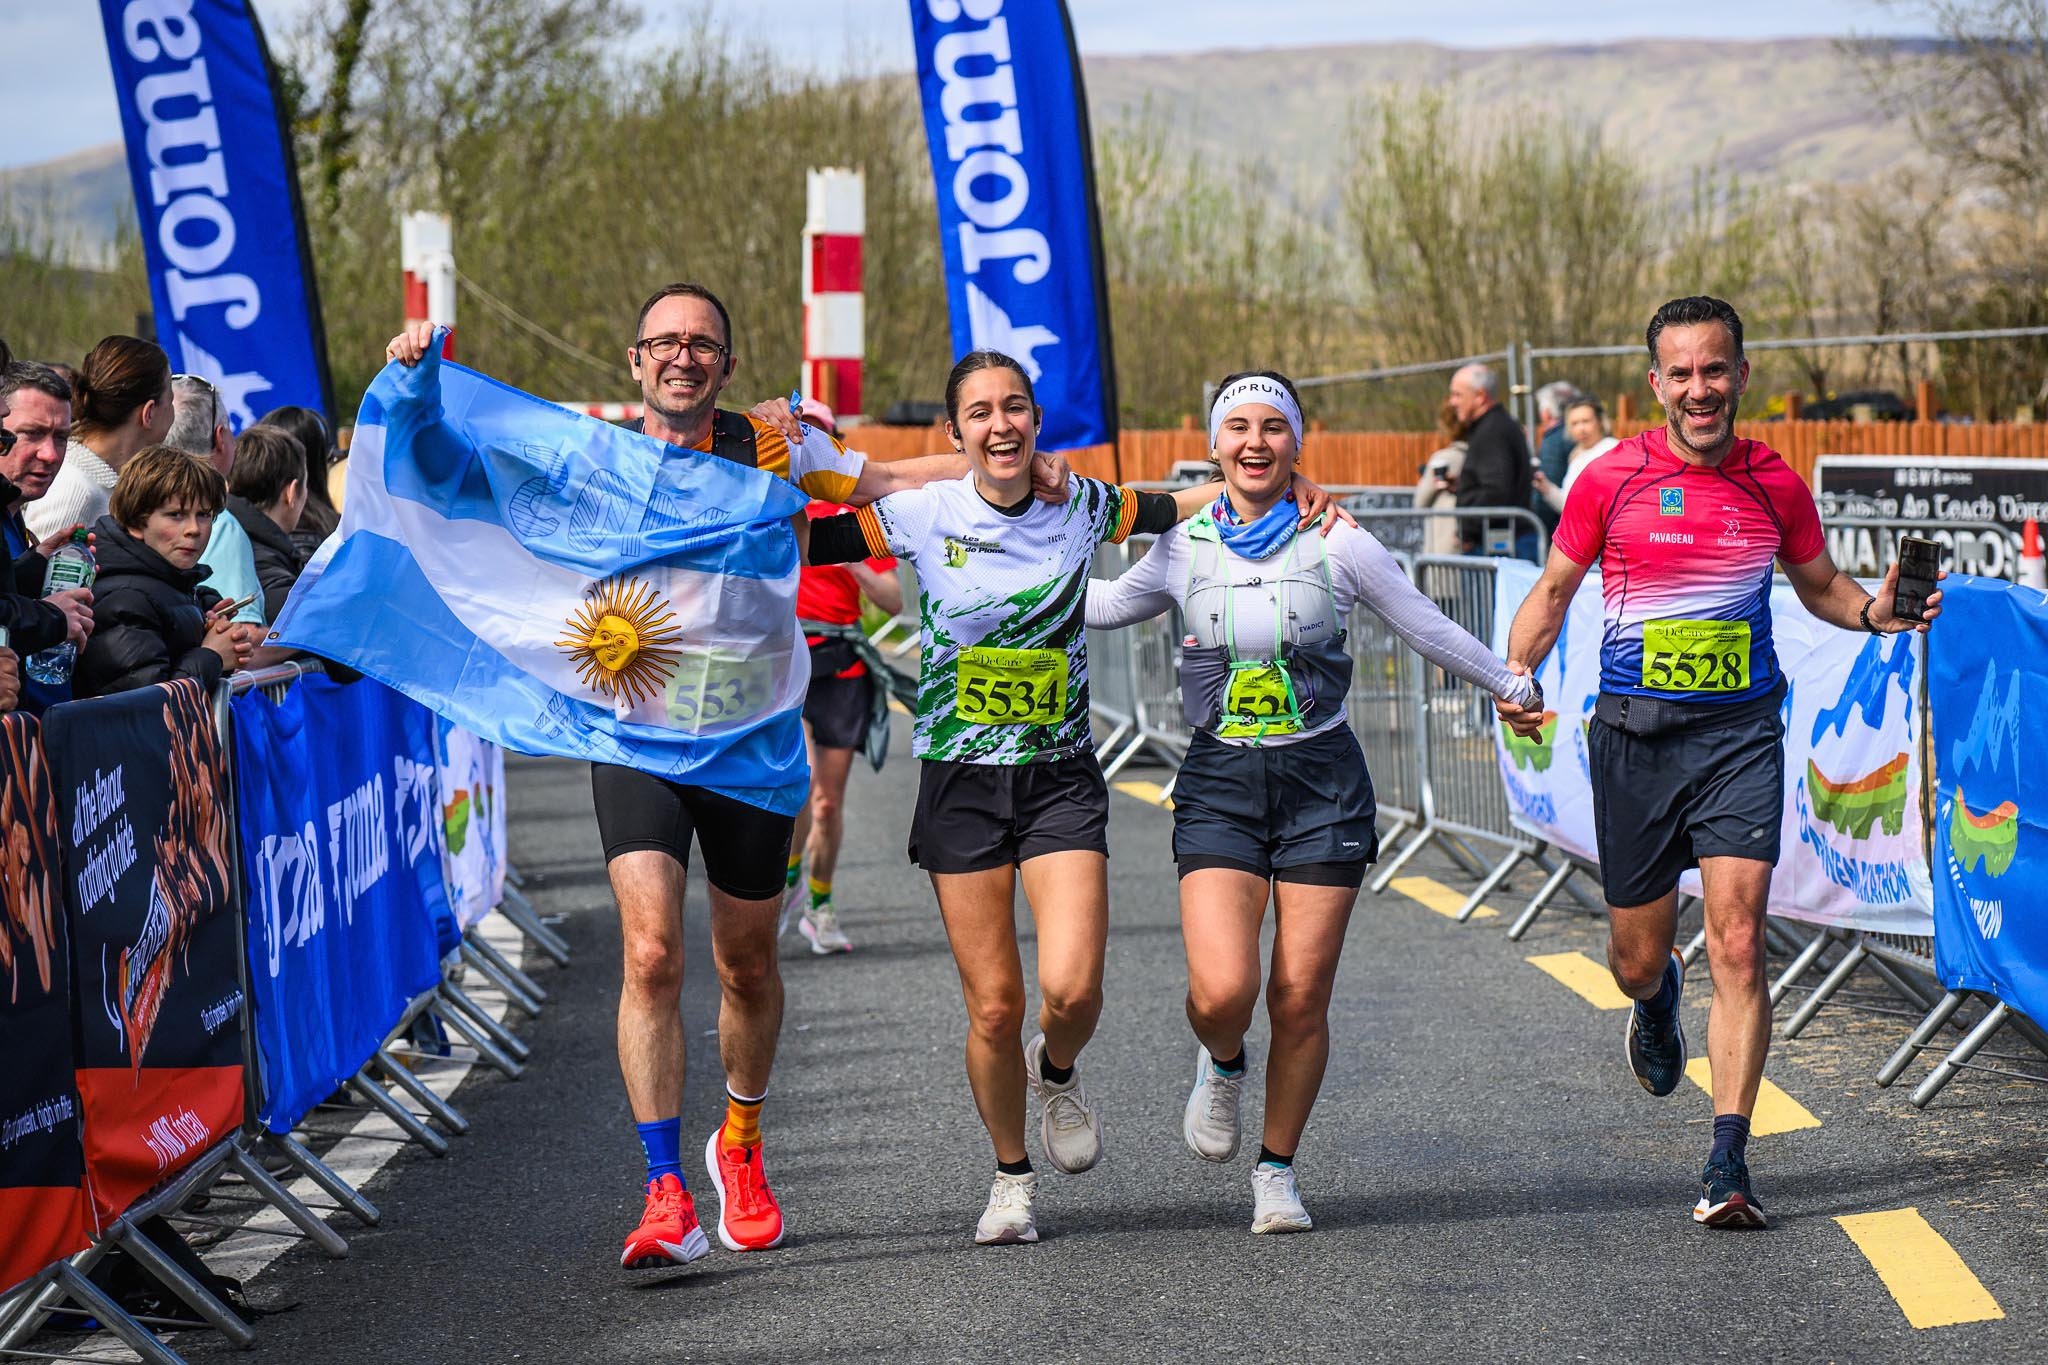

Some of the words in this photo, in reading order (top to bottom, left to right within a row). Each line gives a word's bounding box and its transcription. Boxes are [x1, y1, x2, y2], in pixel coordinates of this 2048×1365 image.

[123, 0, 261, 330] Joma
[1223, 383, 1285, 403] KIPRUN
[1662, 505, 1682, 513] UIPM
[962, 534, 980, 542] Les
[1649, 532, 1694, 545] PAVAGEAU
[1299, 619, 1324, 633] EVADICT
[980, 653, 1022, 666] DeCare
[1650, 652, 1742, 689] 5528
[674, 678, 766, 722] 553
[963, 677, 1059, 717] 5534
[81, 780, 97, 836] the
[95, 764, 125, 825] flavour.
[77, 844, 116, 915] nothing
[106, 833, 120, 882] to
[115, 813, 138, 875] hide.
[344, 772, 389, 926] Joma
[168, 1104, 210, 1148] today.
